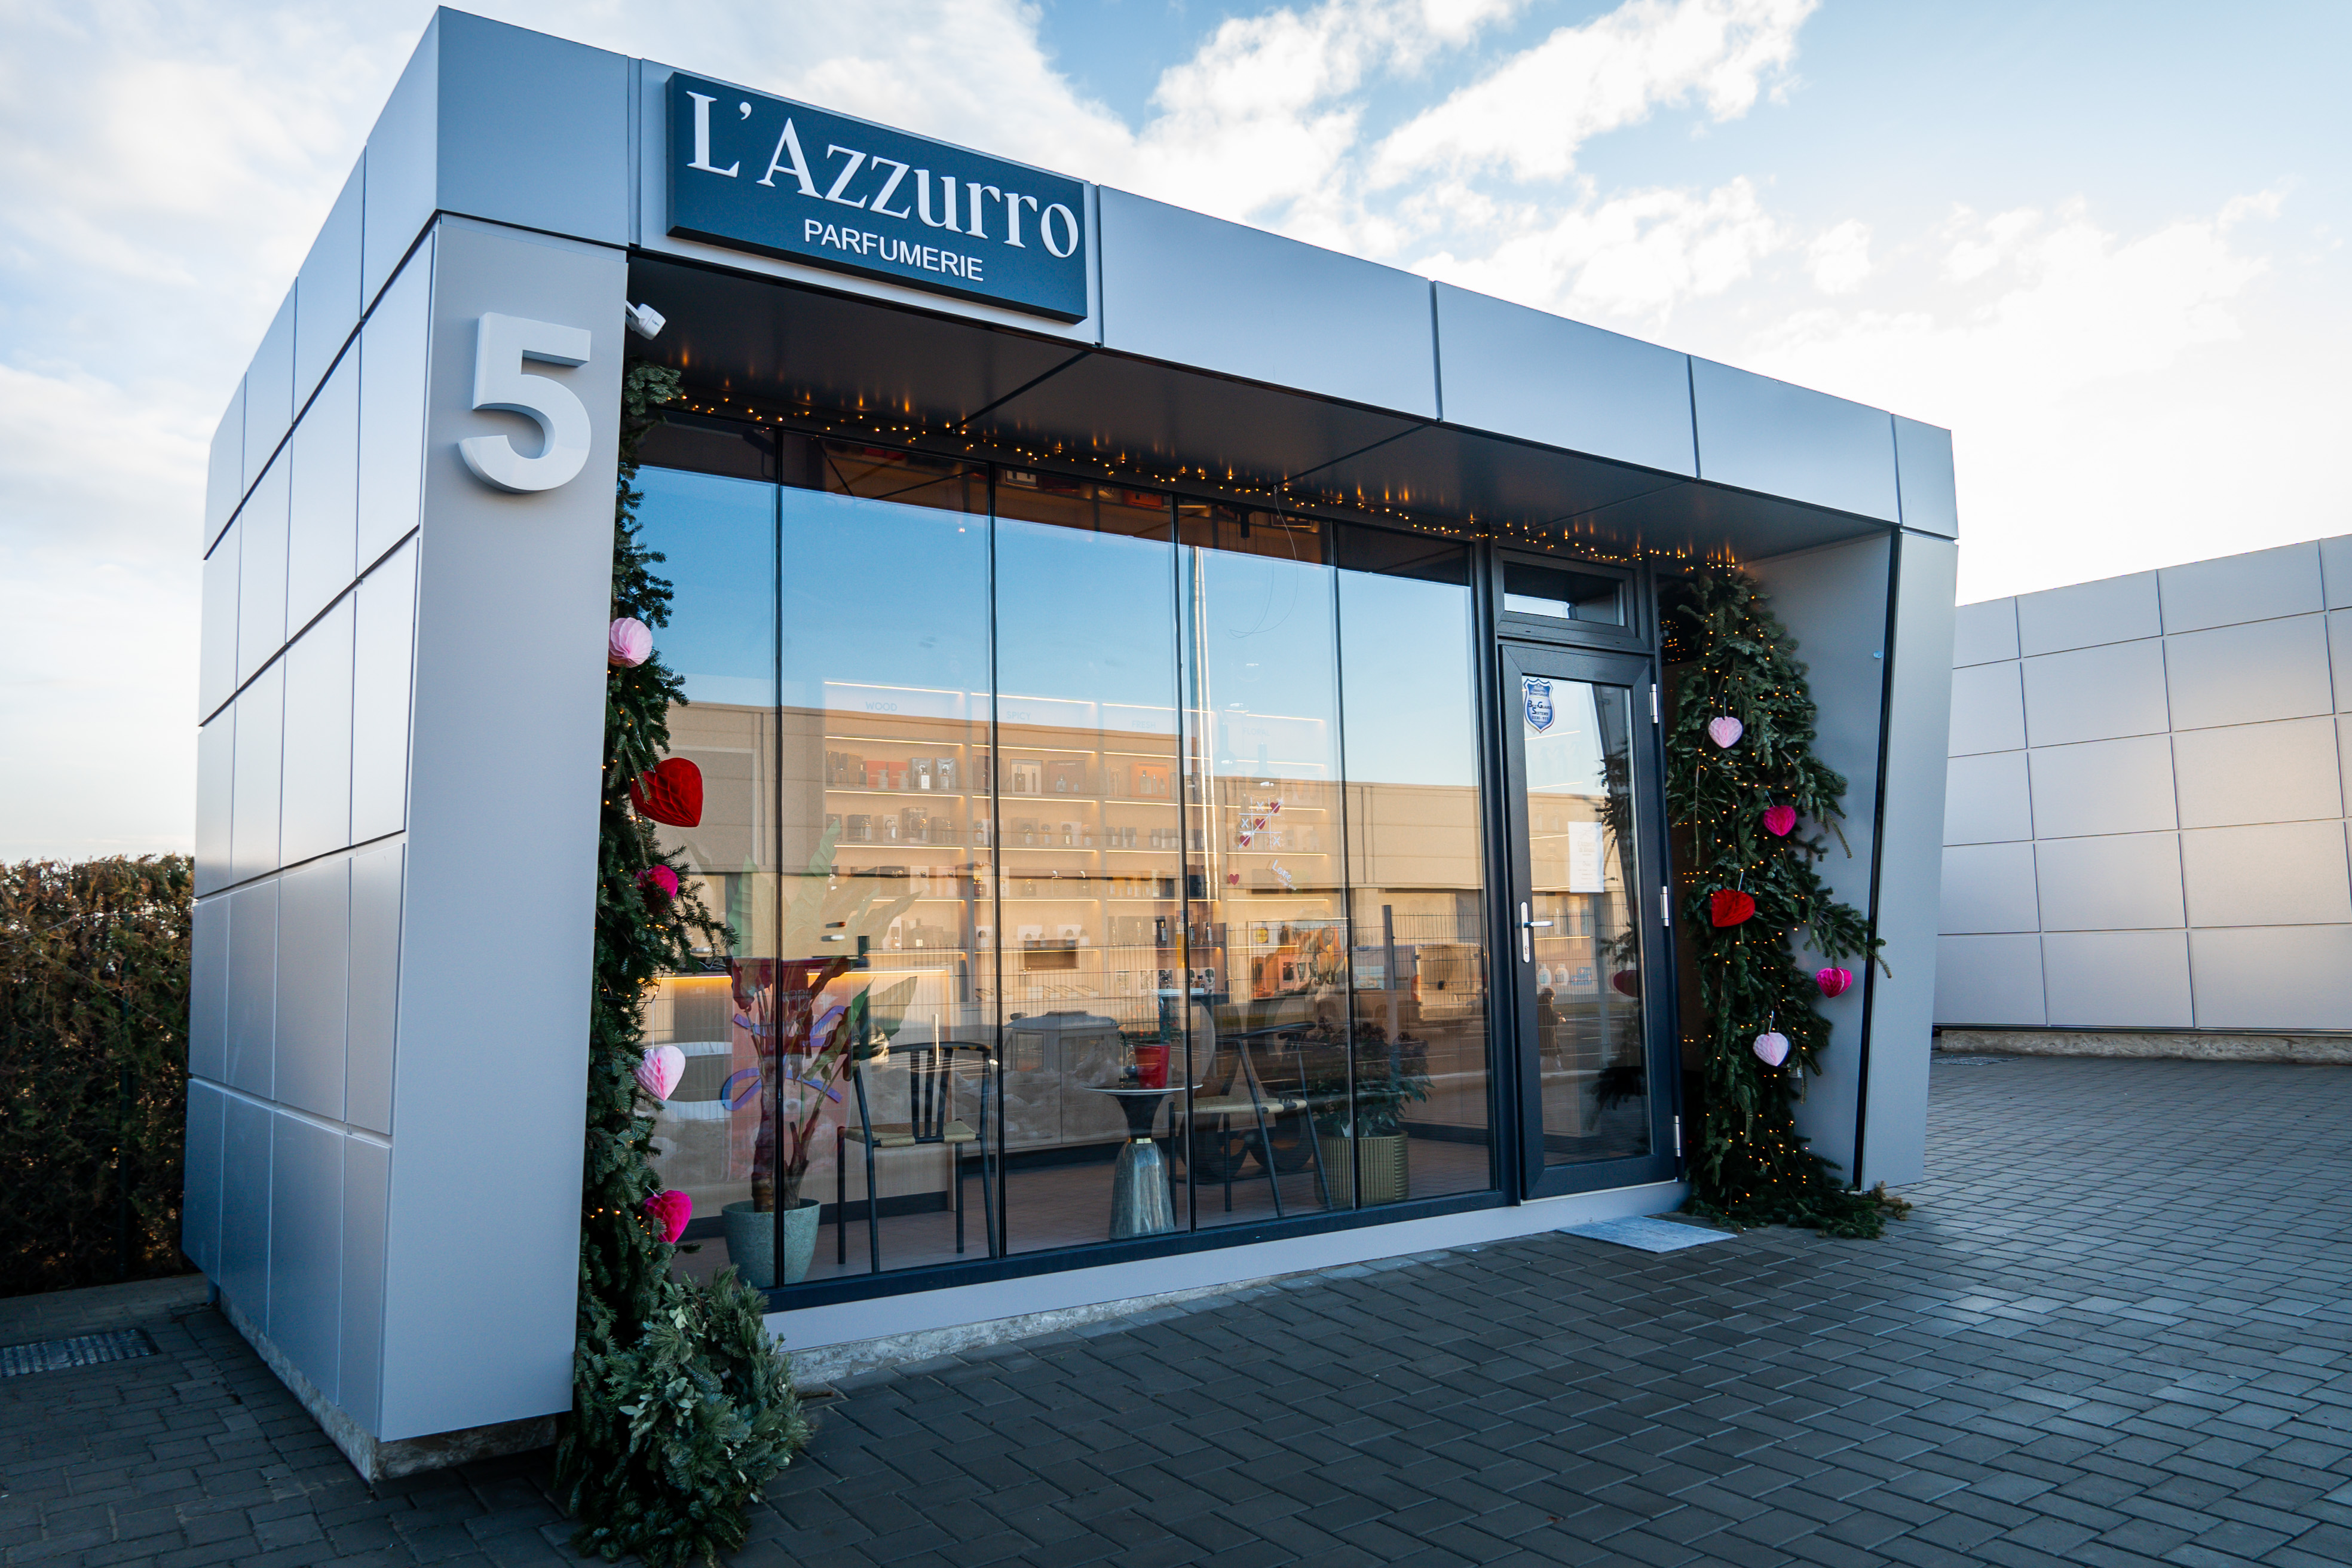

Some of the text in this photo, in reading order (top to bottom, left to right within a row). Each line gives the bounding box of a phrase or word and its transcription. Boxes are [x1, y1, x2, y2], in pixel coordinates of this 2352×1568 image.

[804, 219, 984, 282] PARFUMERIE
[458, 311, 592, 494] 5
[865, 701, 898, 711] WOOD
[1006, 711, 1031, 721] SPICY
[1132, 720, 1156, 729] FRESH
